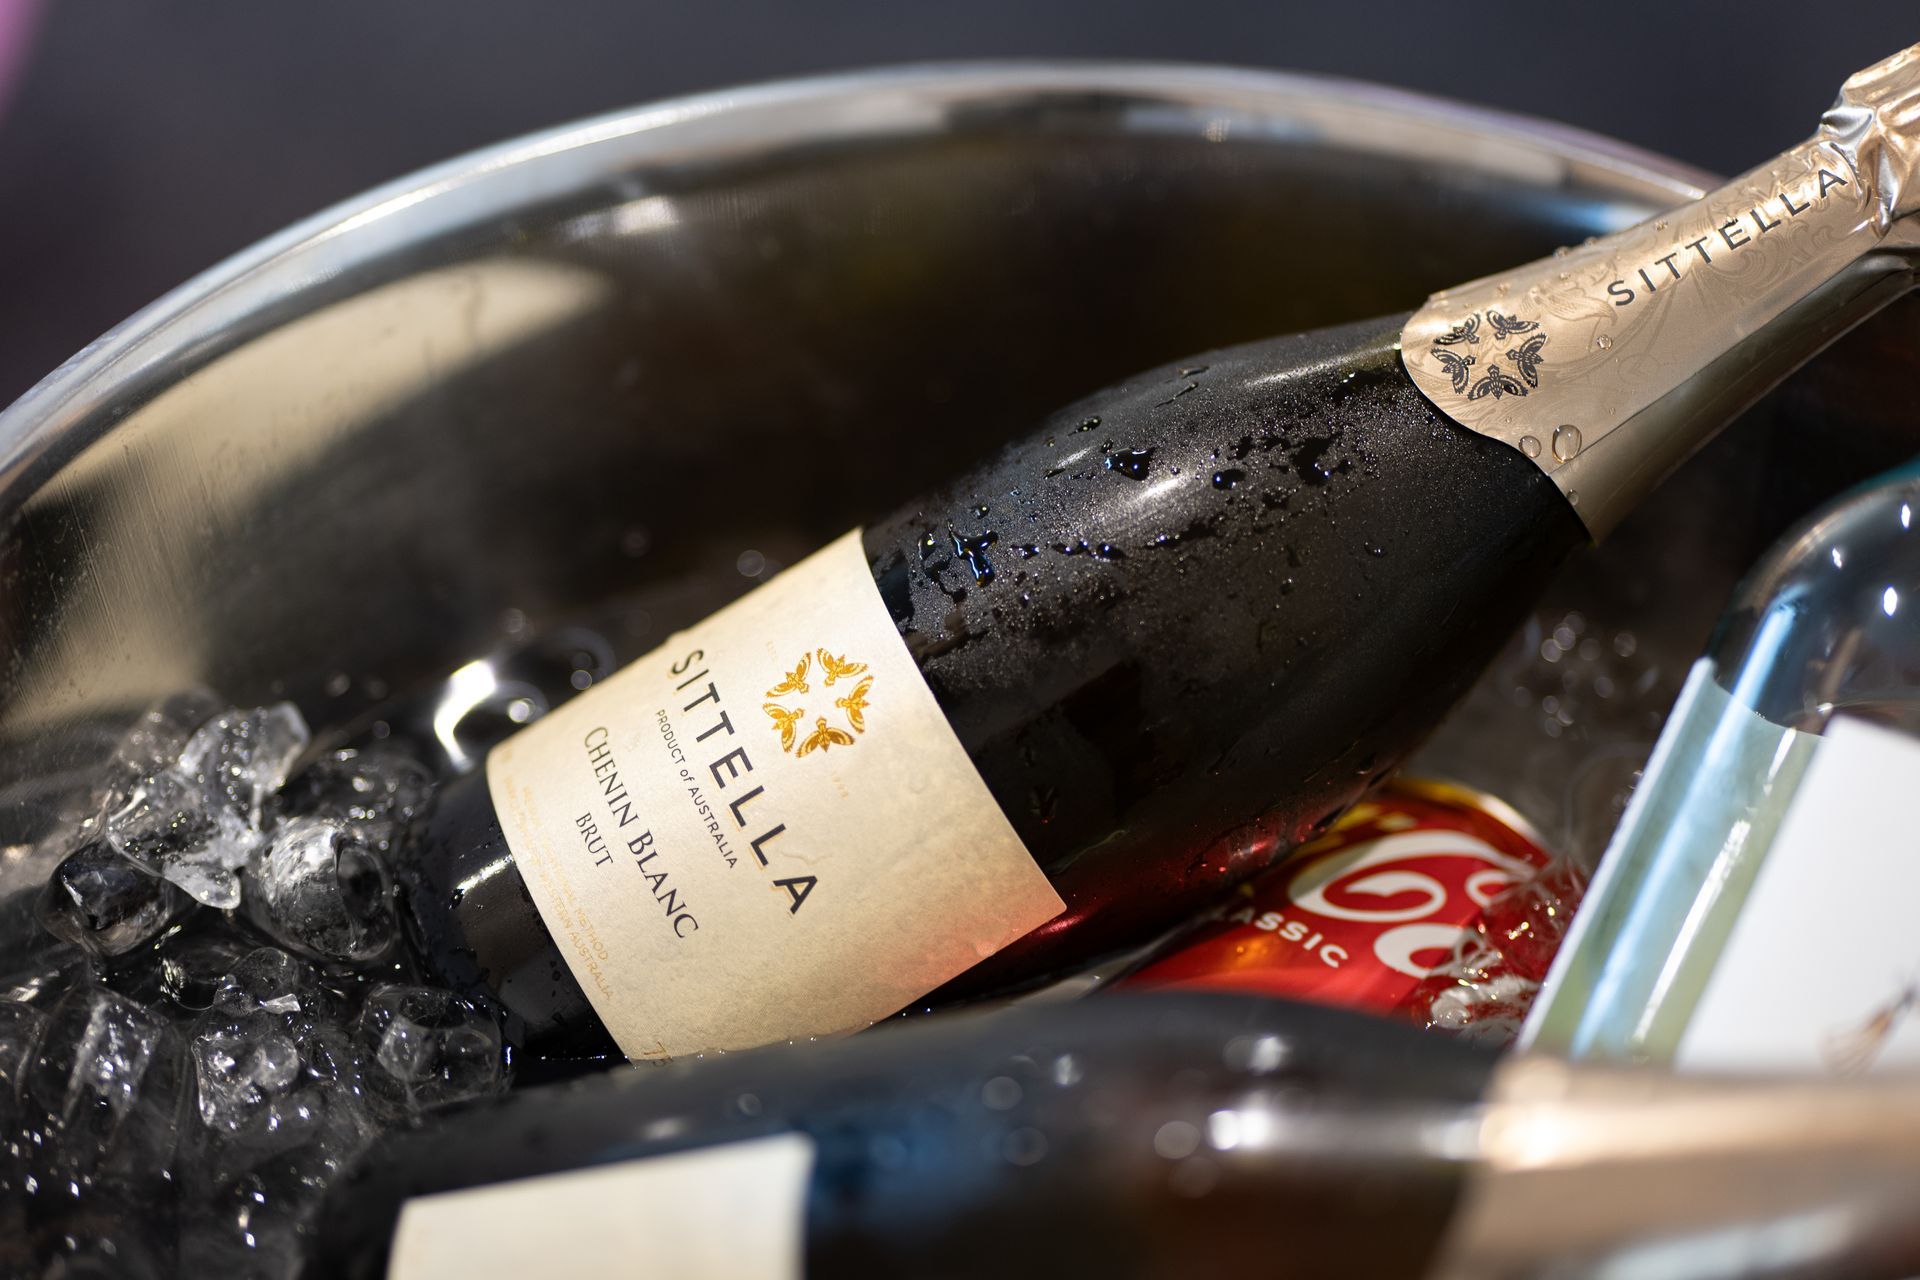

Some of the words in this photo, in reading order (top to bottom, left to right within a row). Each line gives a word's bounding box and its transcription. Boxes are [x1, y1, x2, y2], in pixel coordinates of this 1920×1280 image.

[1606, 167, 1848, 307] SITTELLA
[575, 812, 614, 868] BRUT
[584, 726, 640, 829] CHENIN
[626, 828, 700, 940] BLANC
[656, 708, 686, 765] PRODUCT
[679, 769, 695, 783] of
[687, 786, 738, 870] AUSTRALIA
[670, 649, 818, 915] SITTELLA
[568, 930, 615, 1001] AUSTRALIA
